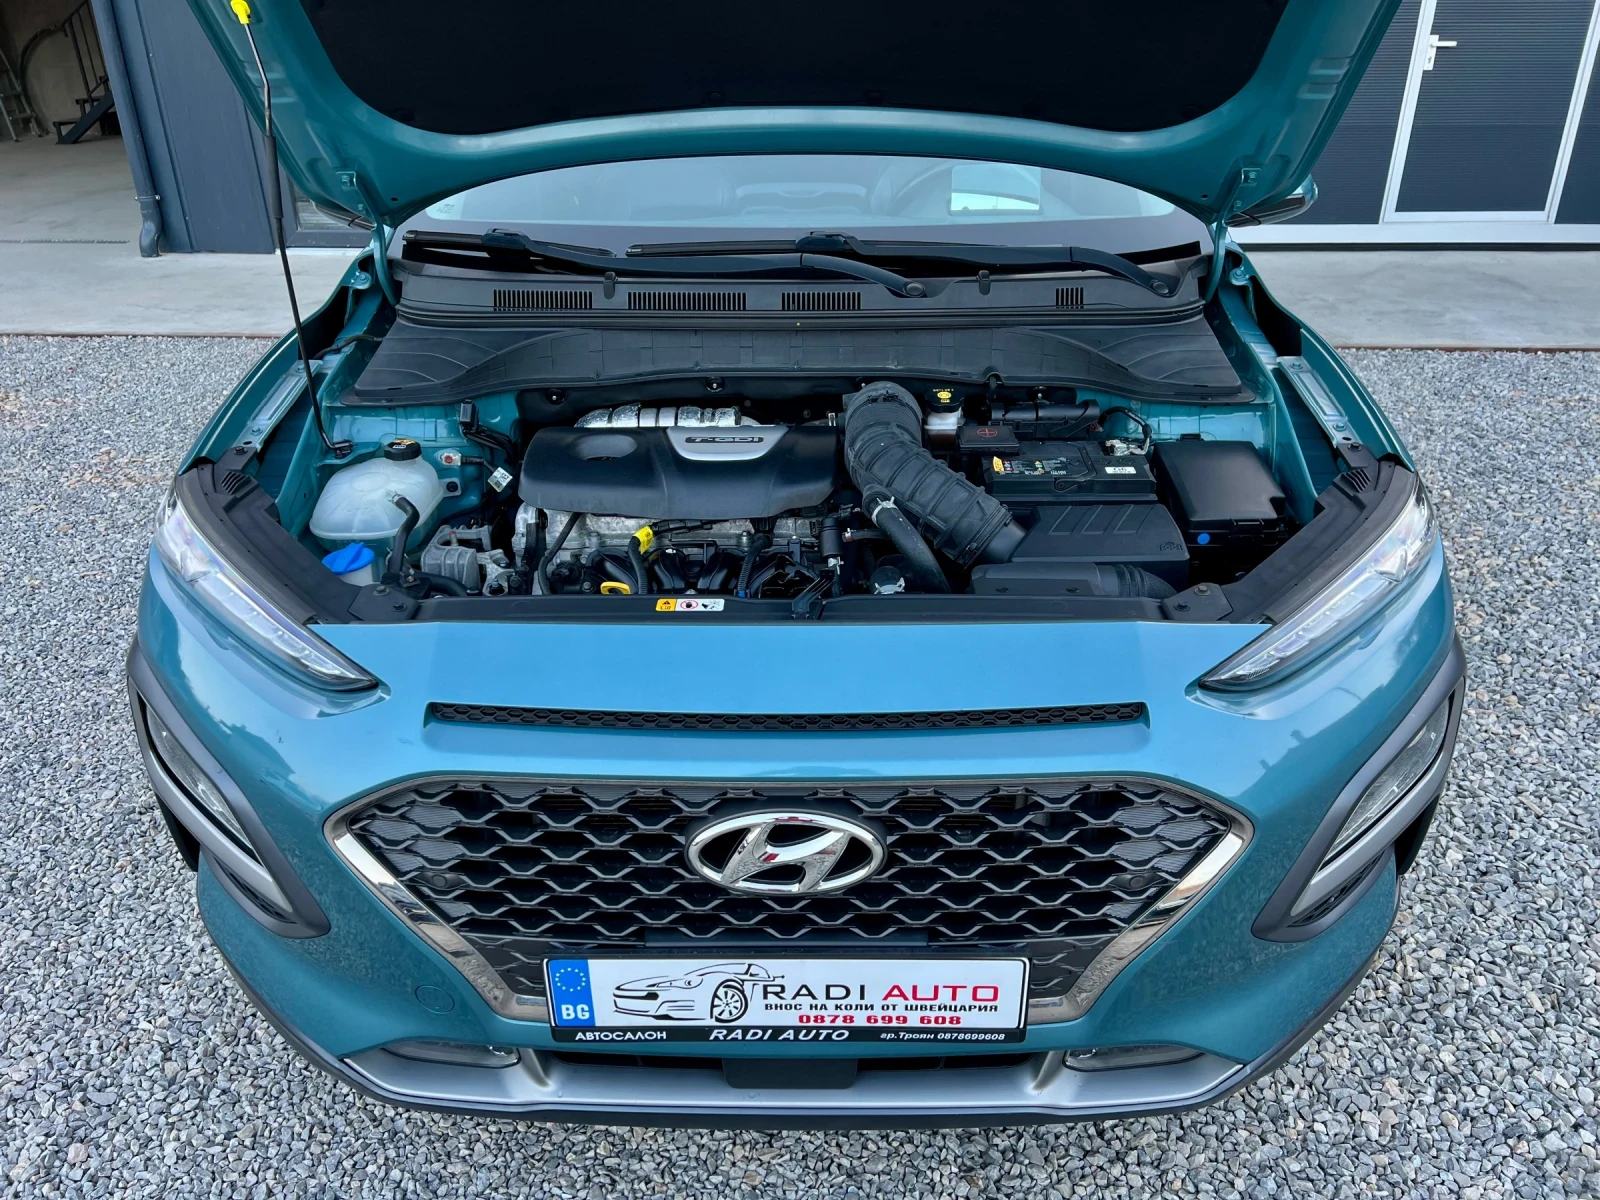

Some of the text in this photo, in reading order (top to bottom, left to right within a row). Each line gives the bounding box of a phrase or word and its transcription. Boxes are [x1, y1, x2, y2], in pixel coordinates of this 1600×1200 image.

[762, 984, 999, 1002] RADI AUTO
[561, 1004, 590, 1020] BG
[764, 1003, 998, 1013] ВНОС НА КОЛИ ОТ ШВЕЙЦАРИЯ
[798, 1014, 962, 1025] 0878 699 608
[575, 1031, 667, 1041] АВТОСАЛОН
[709, 1029, 850, 1041] RADI AUTO
[937, 1032, 1006, 1041] 0878699608
